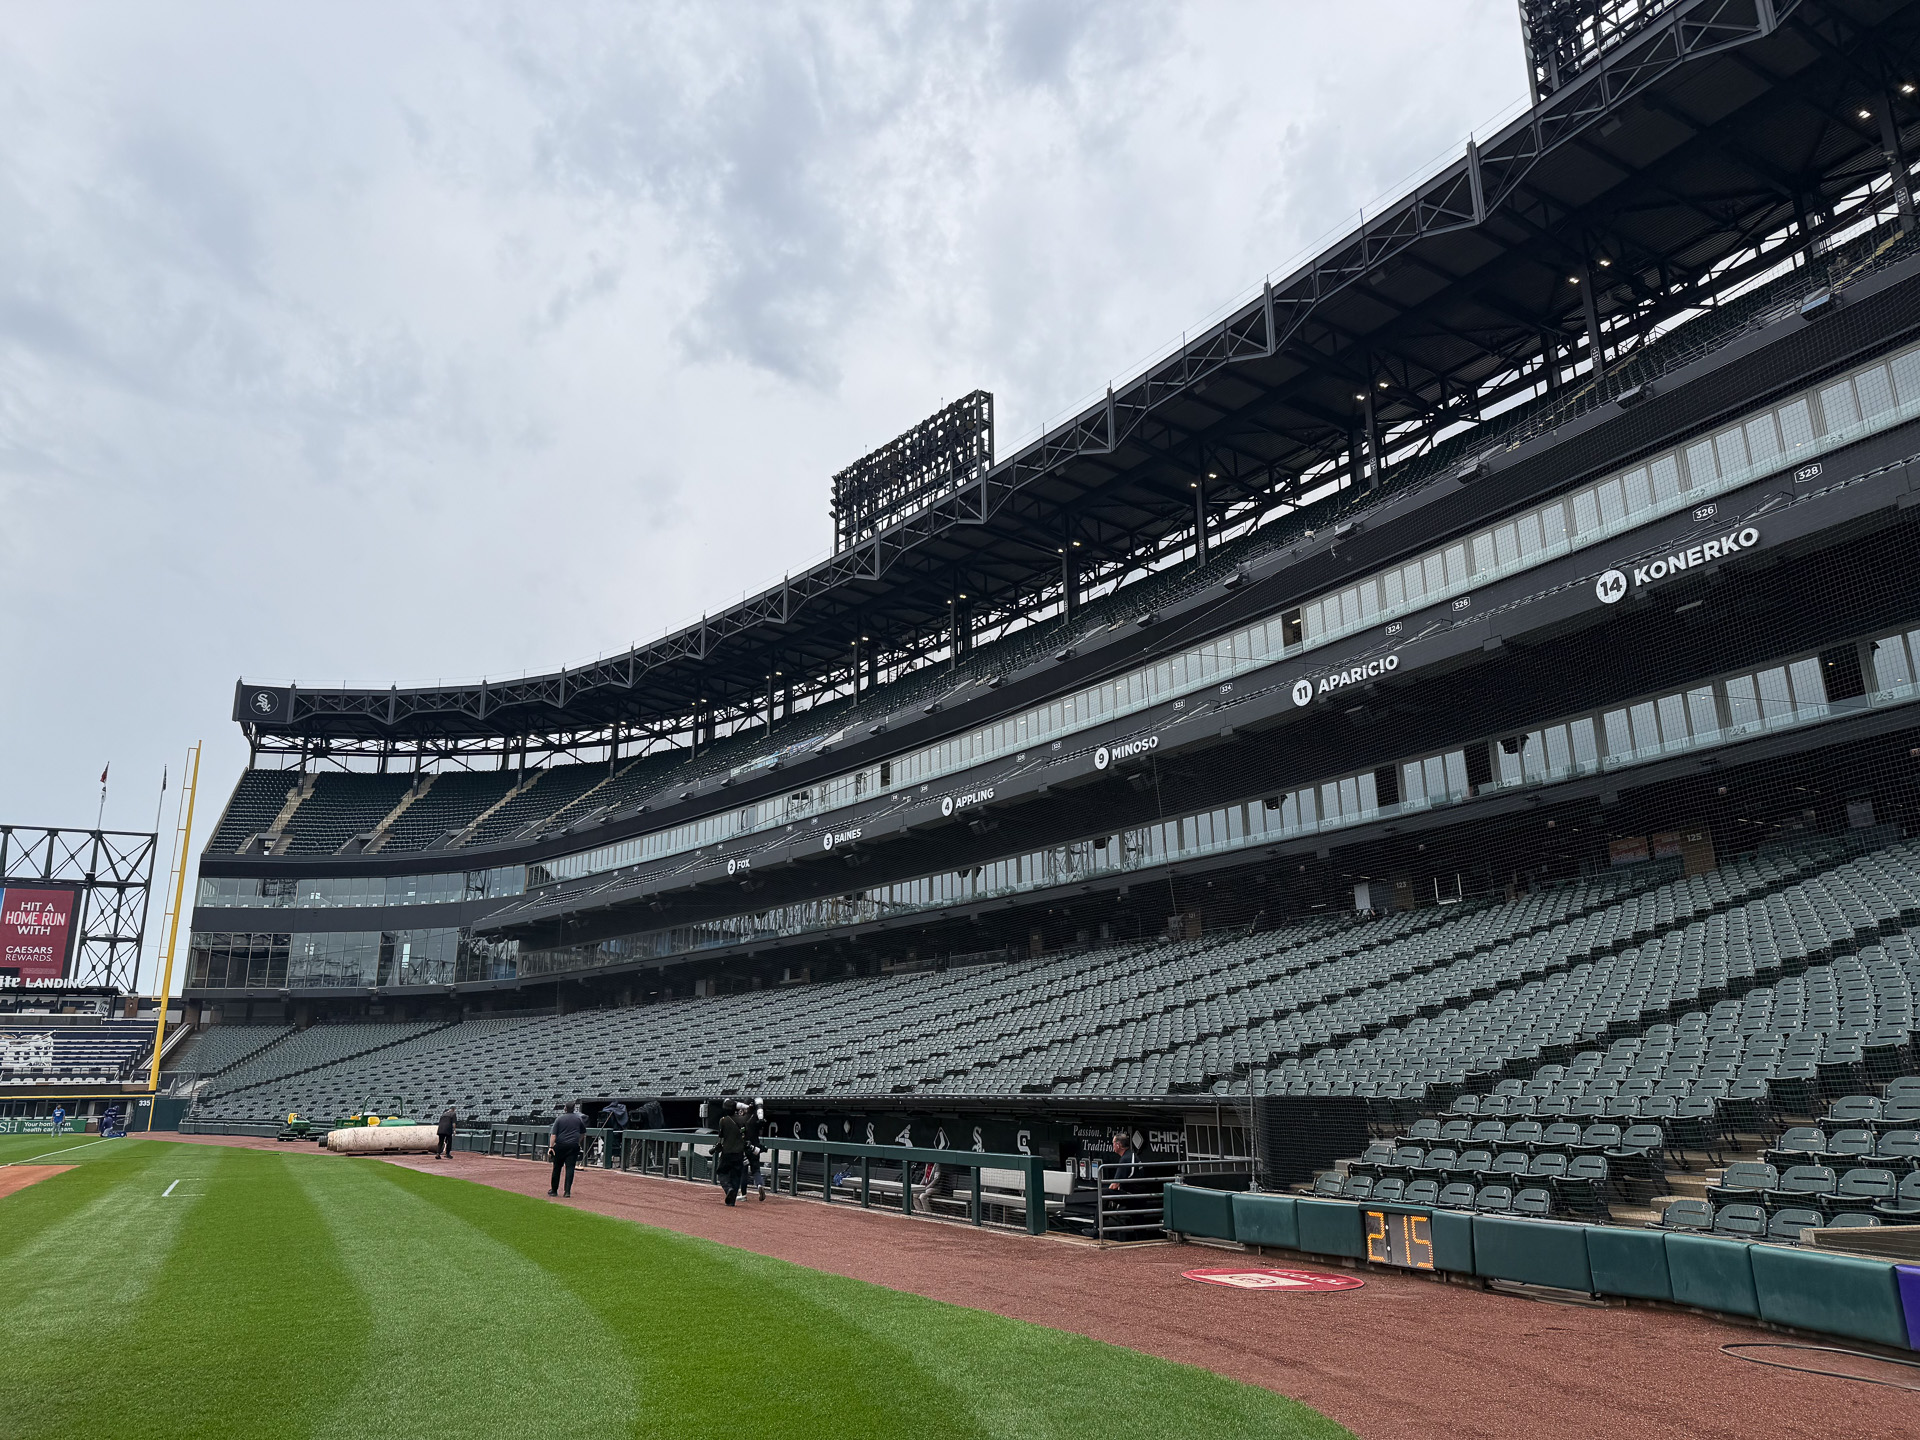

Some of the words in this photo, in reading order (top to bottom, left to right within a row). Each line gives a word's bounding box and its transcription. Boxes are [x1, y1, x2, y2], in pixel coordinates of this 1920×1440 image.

[1798, 466, 1819, 481] 328
[1695, 506, 1714, 519] 326
[1633, 527, 1760, 586] KONERKO
[1454, 600, 1468, 610] 326
[1387, 624, 1401, 634] 324
[1318, 655, 1399, 694] APARICIO
[1112, 736, 1159, 760] MINOSO
[955, 788, 995, 809] APPLING
[834, 828, 862, 844] BAINES
[1686, 833, 1702, 842] 125
[737, 859, 750, 870] FOX
[20, 902, 42, 911] HIT
[45, 902, 55, 912] A
[5, 911, 39, 925] HOME
[41, 912, 66, 926] RUN
[17, 925, 51, 935] WITH
[6, 945, 53, 954] CAESARS
[25, 977, 87, 989] LANDING
[1073, 1125, 1102, 1138] Passion.
[1082, 1139, 1115, 1153] Traditio
